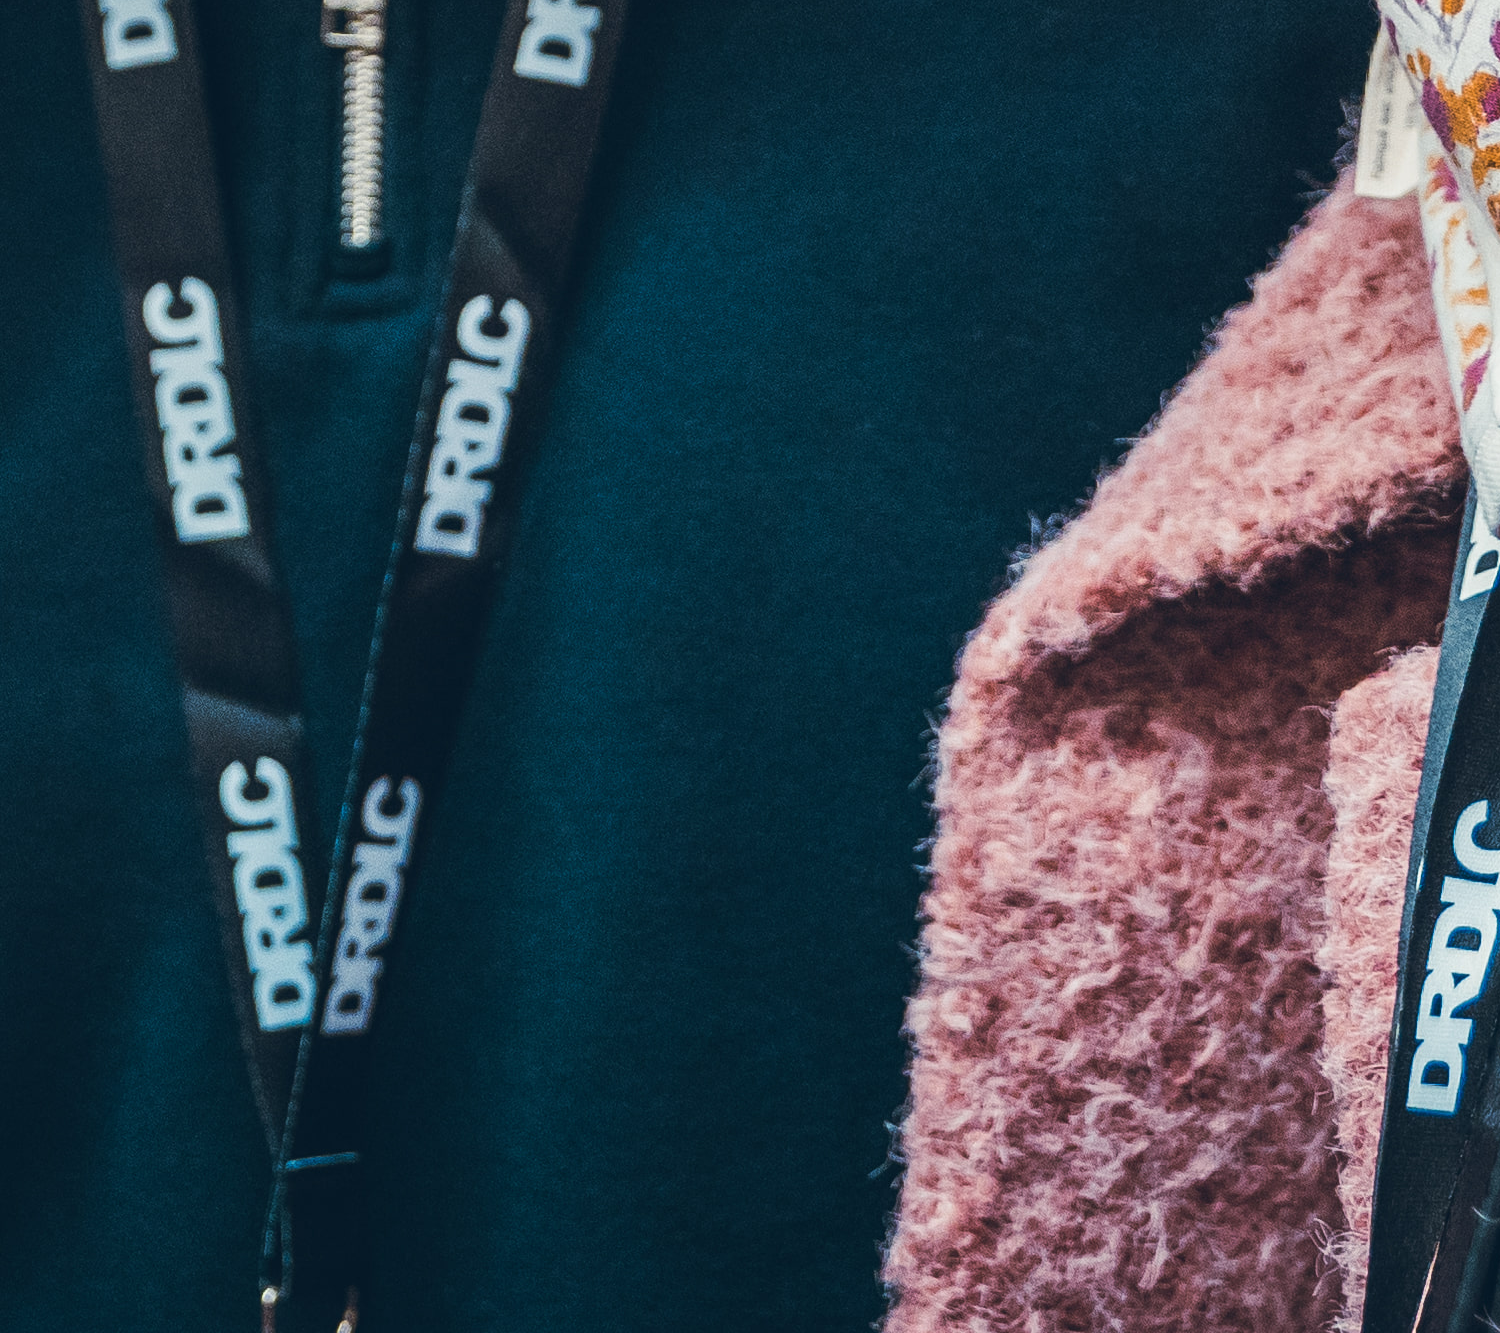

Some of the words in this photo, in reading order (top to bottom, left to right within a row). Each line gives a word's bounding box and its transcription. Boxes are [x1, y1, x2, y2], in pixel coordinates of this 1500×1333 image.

[141, 276, 251, 542] DRDLC
[415, 294, 531, 558] DRDLC
[218, 756, 318, 1032] DRDLC
[322, 777, 420, 1033] DRDLC
